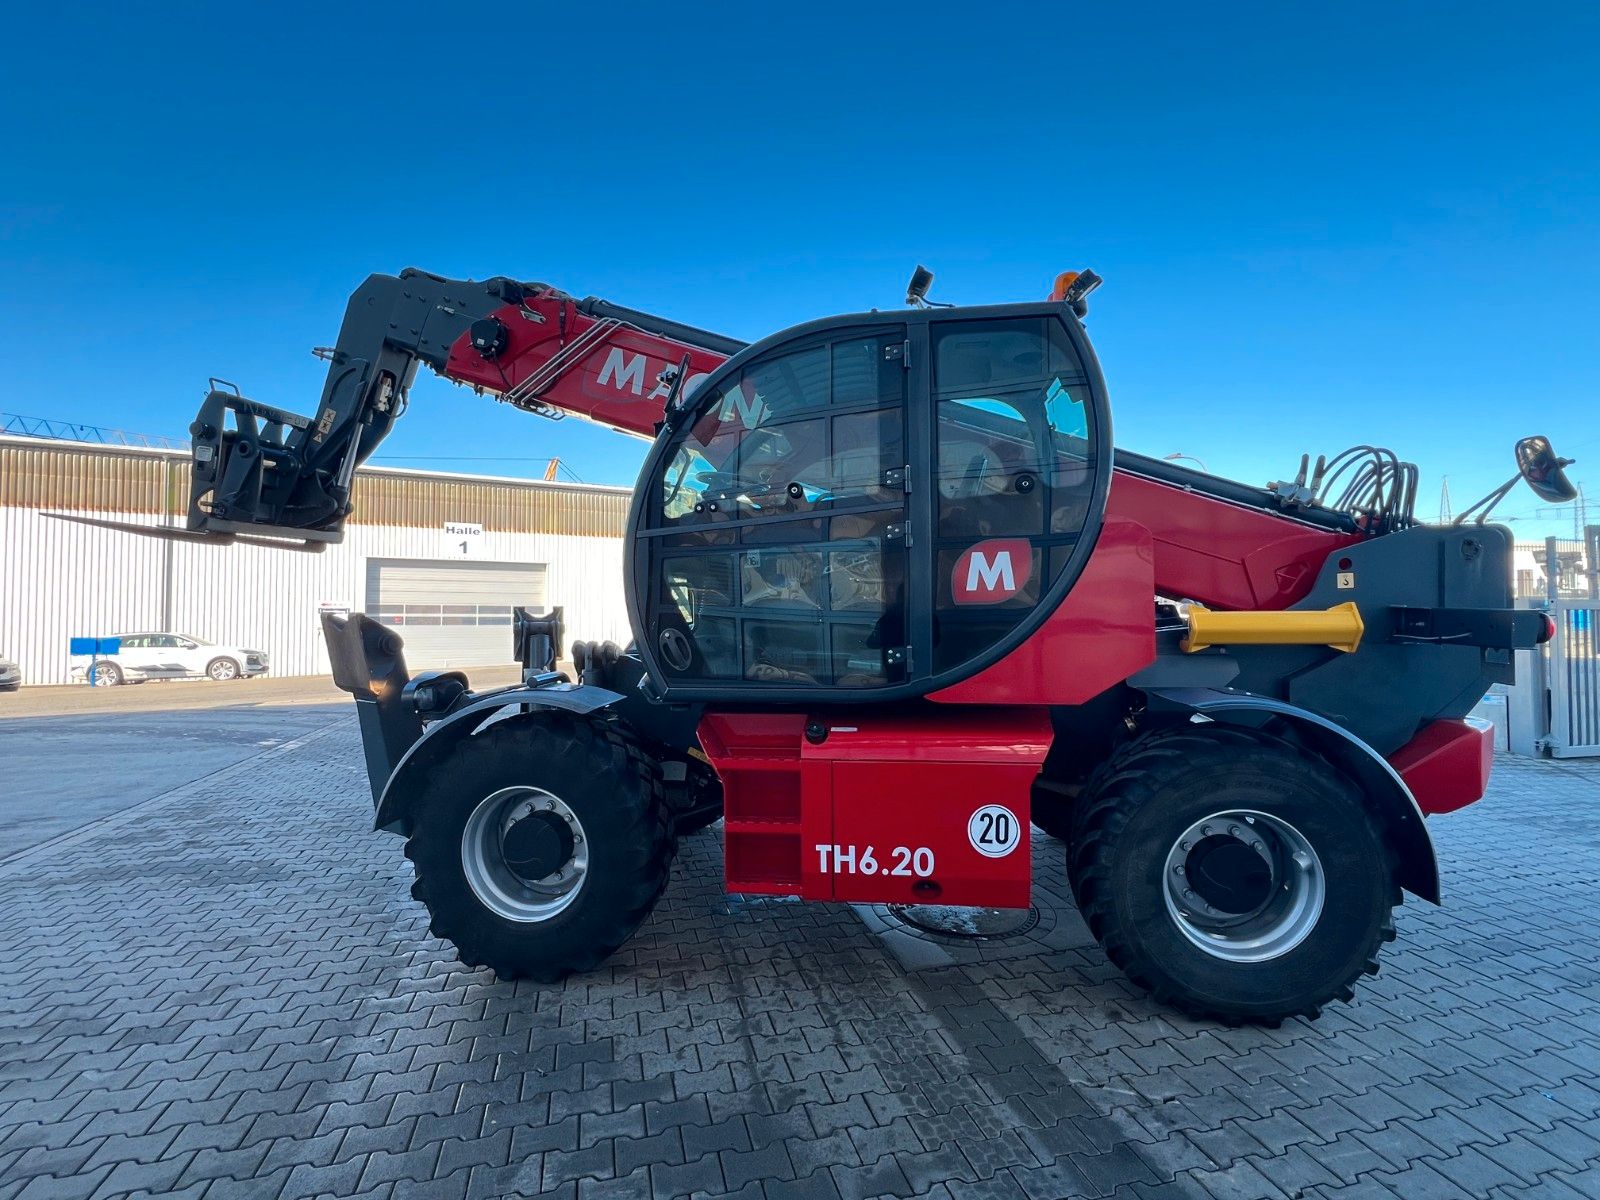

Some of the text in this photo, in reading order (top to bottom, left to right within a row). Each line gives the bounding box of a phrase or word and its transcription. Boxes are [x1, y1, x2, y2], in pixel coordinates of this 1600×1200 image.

[446, 526, 481, 536] Halle
[459, 541, 467, 554] 1
[966, 551, 1016, 591] M
[979, 812, 1010, 845] 20
[815, 844, 935, 877] TH6.20
